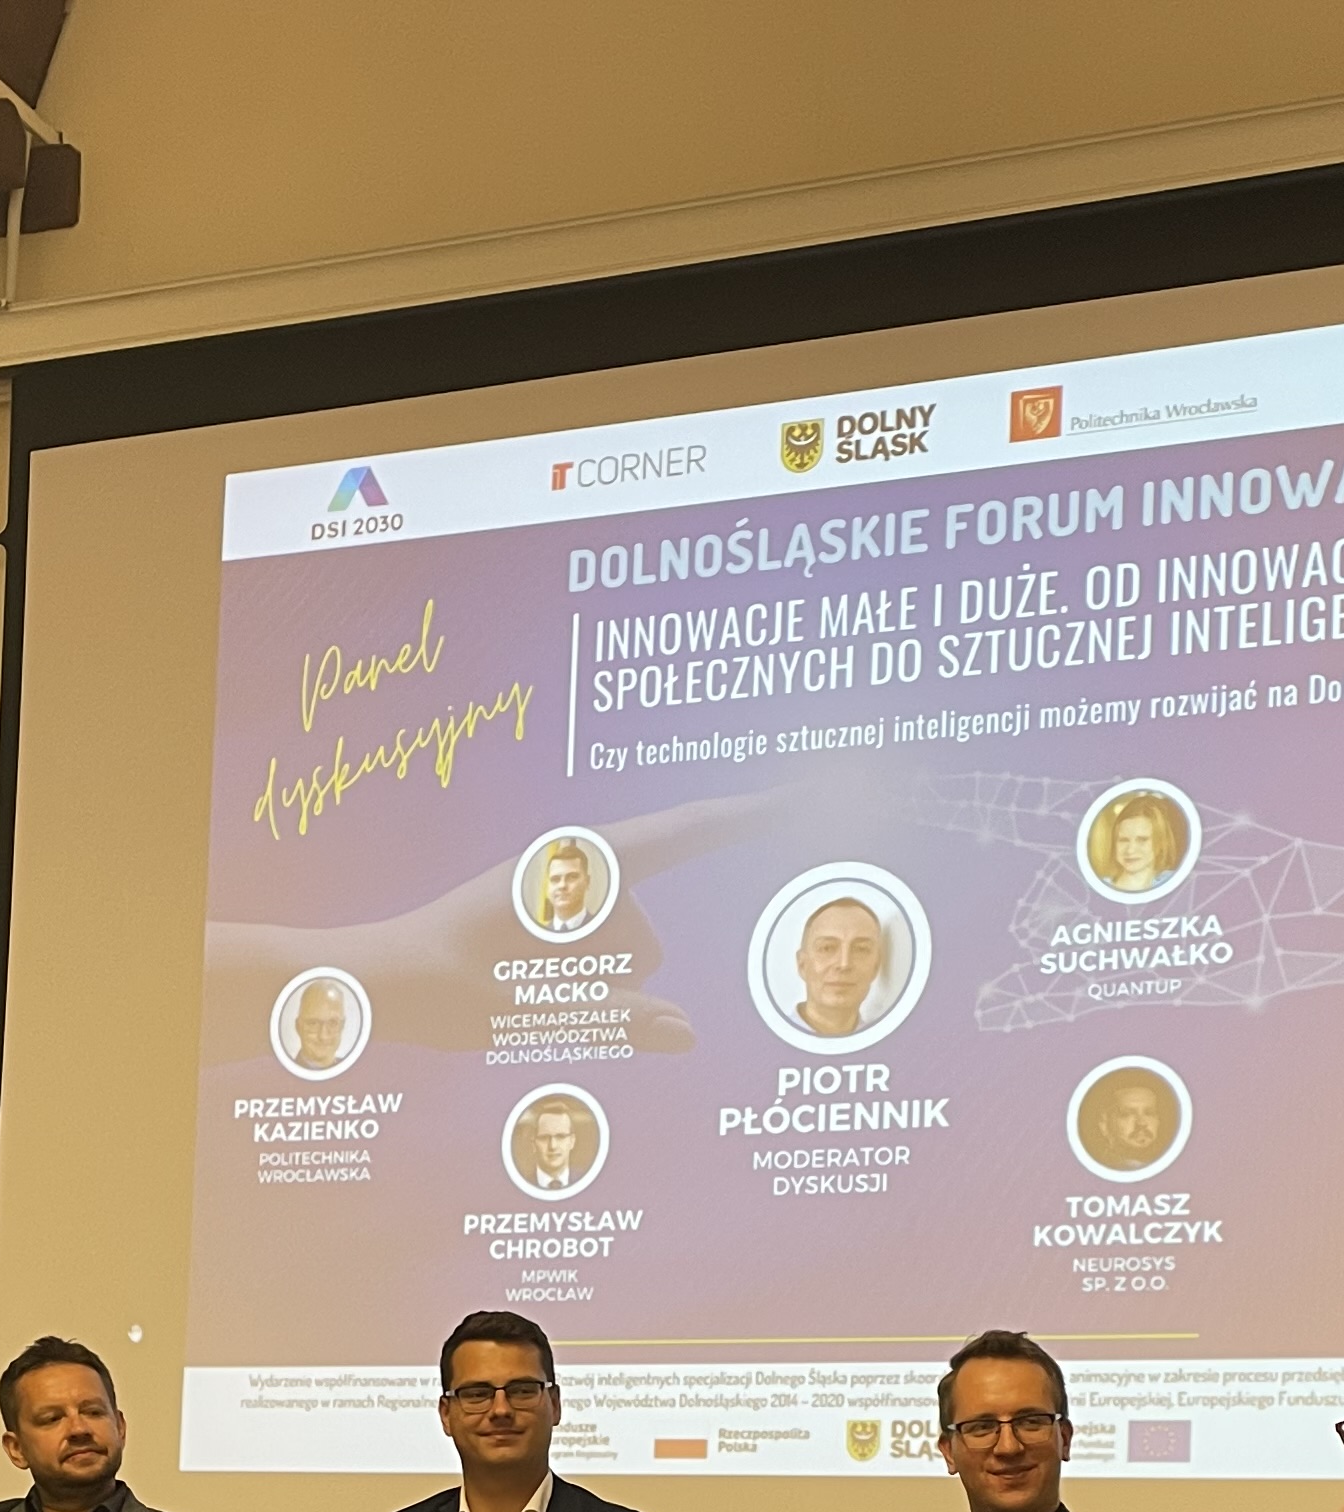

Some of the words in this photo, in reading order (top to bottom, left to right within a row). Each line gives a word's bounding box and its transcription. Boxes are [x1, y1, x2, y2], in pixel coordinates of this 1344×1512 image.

[836, 404, 936, 438] DOLNY
[1069, 406, 1161, 432] Politechnika
[1165, 392, 1258, 419] Wrocławska
[835, 428, 929, 464] ŚLĄSK
[310, 518, 347, 541] DSI
[353, 512, 404, 537] 2030
[568, 508, 930, 593] DOLNOŚLĄSKIE
[945, 484, 1124, 550] FORUM
[595, 600, 805, 663] INNOWACJE
[820, 590, 918, 640] MAŁE
[933, 584, 943, 627] I
[960, 564, 1069, 625] DUŻE.
[1084, 561, 1141, 612] OD
[301, 599, 445, 732] Panel
[592, 650, 853, 714] SPOŁECZNYCH
[870, 642, 922, 688] DO
[936, 614, 1153, 681] SZTUCZNEJ
[590, 742, 626, 772] Czy
[636, 728, 768, 770] technologie
[776, 718, 885, 754] sztucznej
[893, 693, 1031, 742] inteligencji
[1039, 696, 1142, 732] możemy
[1150, 680, 1258, 721] rozwijać
[1267, 683, 1298, 709] na
[254, 678, 533, 840] dyskusyjny
[1050, 914, 1223, 948] AGNIESZKA
[493, 953, 633, 982] GRZEGORZ
[1040, 941, 1233, 975] SUCHWAŁKO
[513, 982, 609, 1006] MACKO
[1087, 979, 1182, 1000] QUANTUP
[490, 1008, 632, 1030] WICEMARSZAŁEK
[492, 1026, 628, 1047] WOJEWÓDZTWA
[486, 1044, 634, 1066] DOLNOŚLĄSKIEGO
[777, 1063, 890, 1096] PIOTR
[233, 1093, 403, 1119] PRZEMYSŁAW
[719, 1097, 950, 1136] PŁÓCIENNIK
[253, 1119, 380, 1143] KAZIENKO
[258, 1150, 371, 1167] POLITECHNIKA
[753, 1145, 911, 1170] MODERATOR
[773, 1173, 888, 1196] DYSKUSJI
[1065, 1193, 1191, 1218] TOMASZ
[463, 1209, 643, 1236] PRZEMYSŁAW
[1033, 1221, 1223, 1247] KOWALCZYK
[489, 1237, 614, 1260] CHROBOT
[521, 1269, 578, 1285] MPWIK
[1072, 1255, 1176, 1273] NEUROSYS
[891, 1420, 942, 1438] DOL
